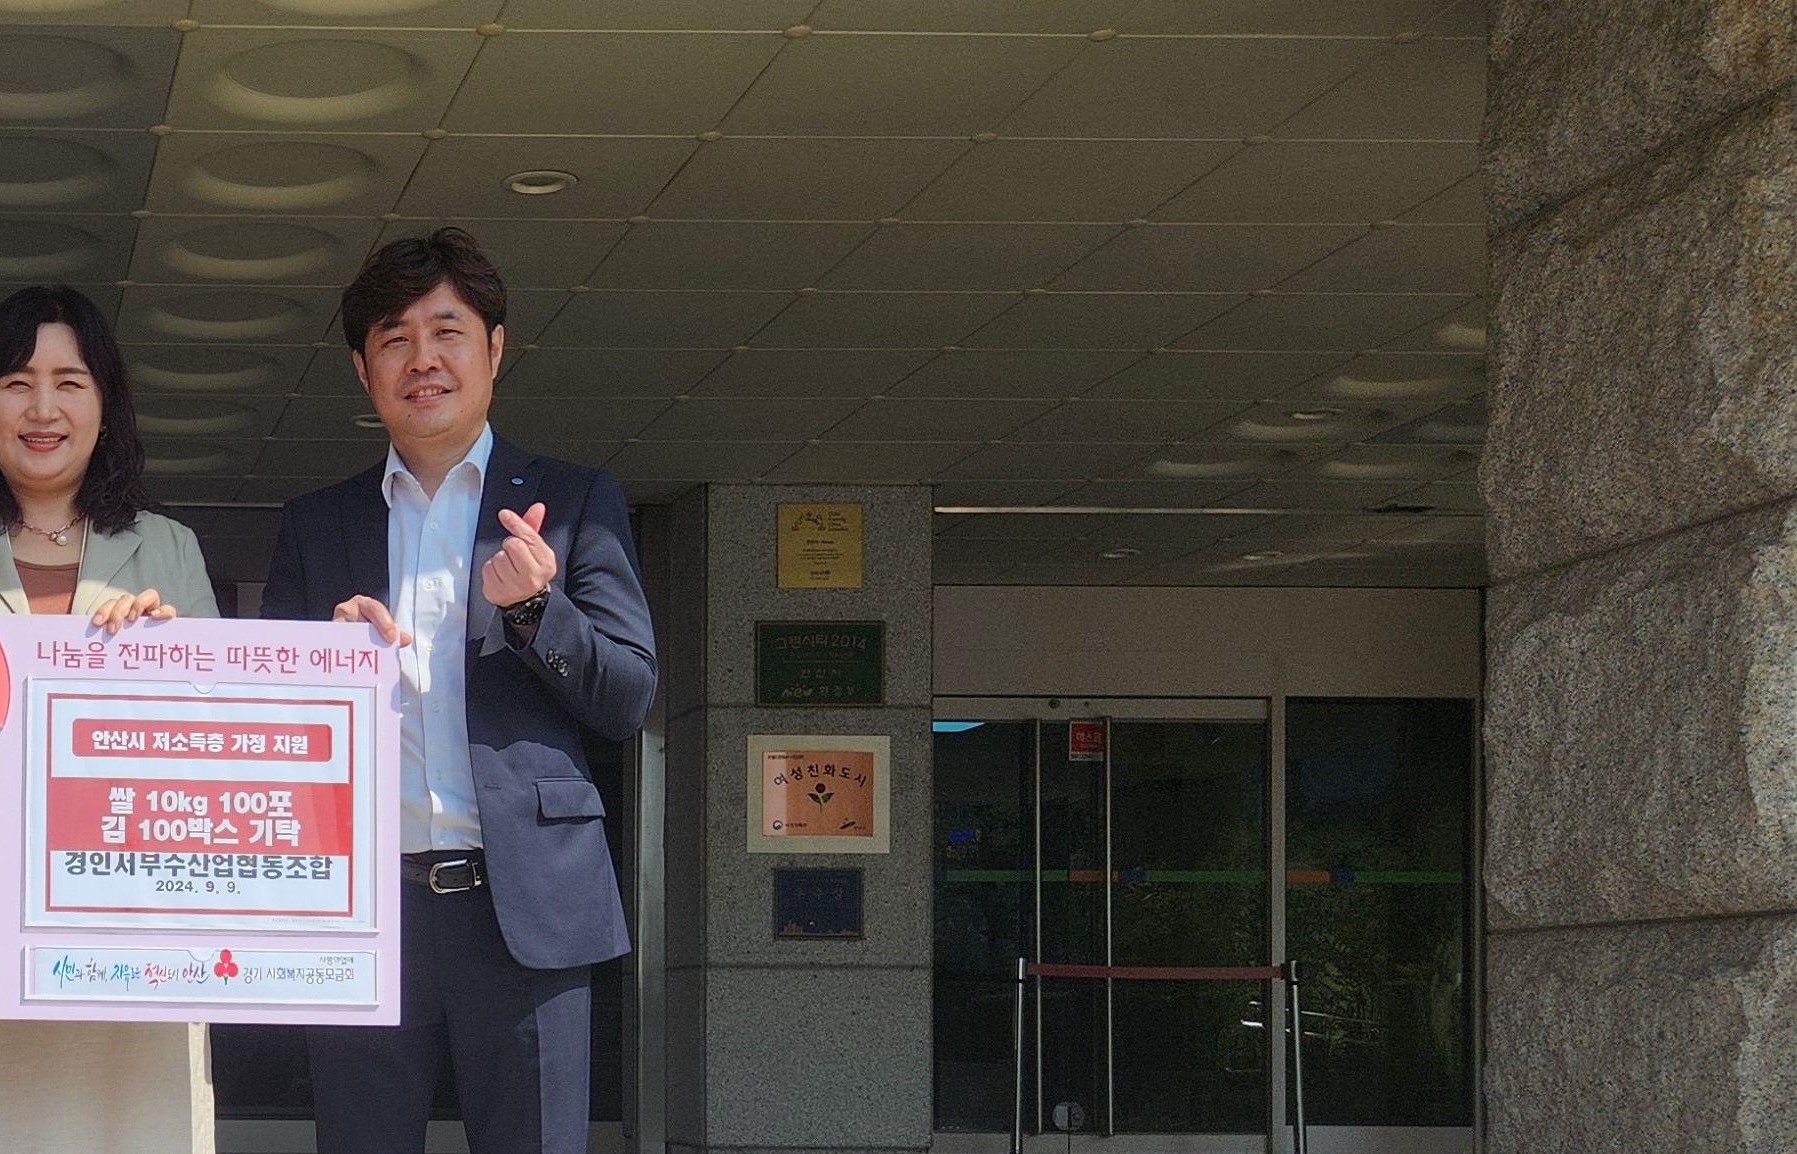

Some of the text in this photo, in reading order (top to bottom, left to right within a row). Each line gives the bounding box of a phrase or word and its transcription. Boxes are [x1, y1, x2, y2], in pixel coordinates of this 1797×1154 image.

[37, 641, 380, 675] 나눔을 전파하는 따뜻한 에너지
[92, 730, 309, 754] 안산시 저소득층 가정 지원
[774, 764, 867, 788] 여성친화도시
[109, 787, 293, 818] 쌀 10kg 100포
[101, 816, 301, 847] 김 100박스 기탁
[65, 851, 333, 880] 경인서부수산업협동조합
[155, 880, 241, 895] 2024. 9. 9.
